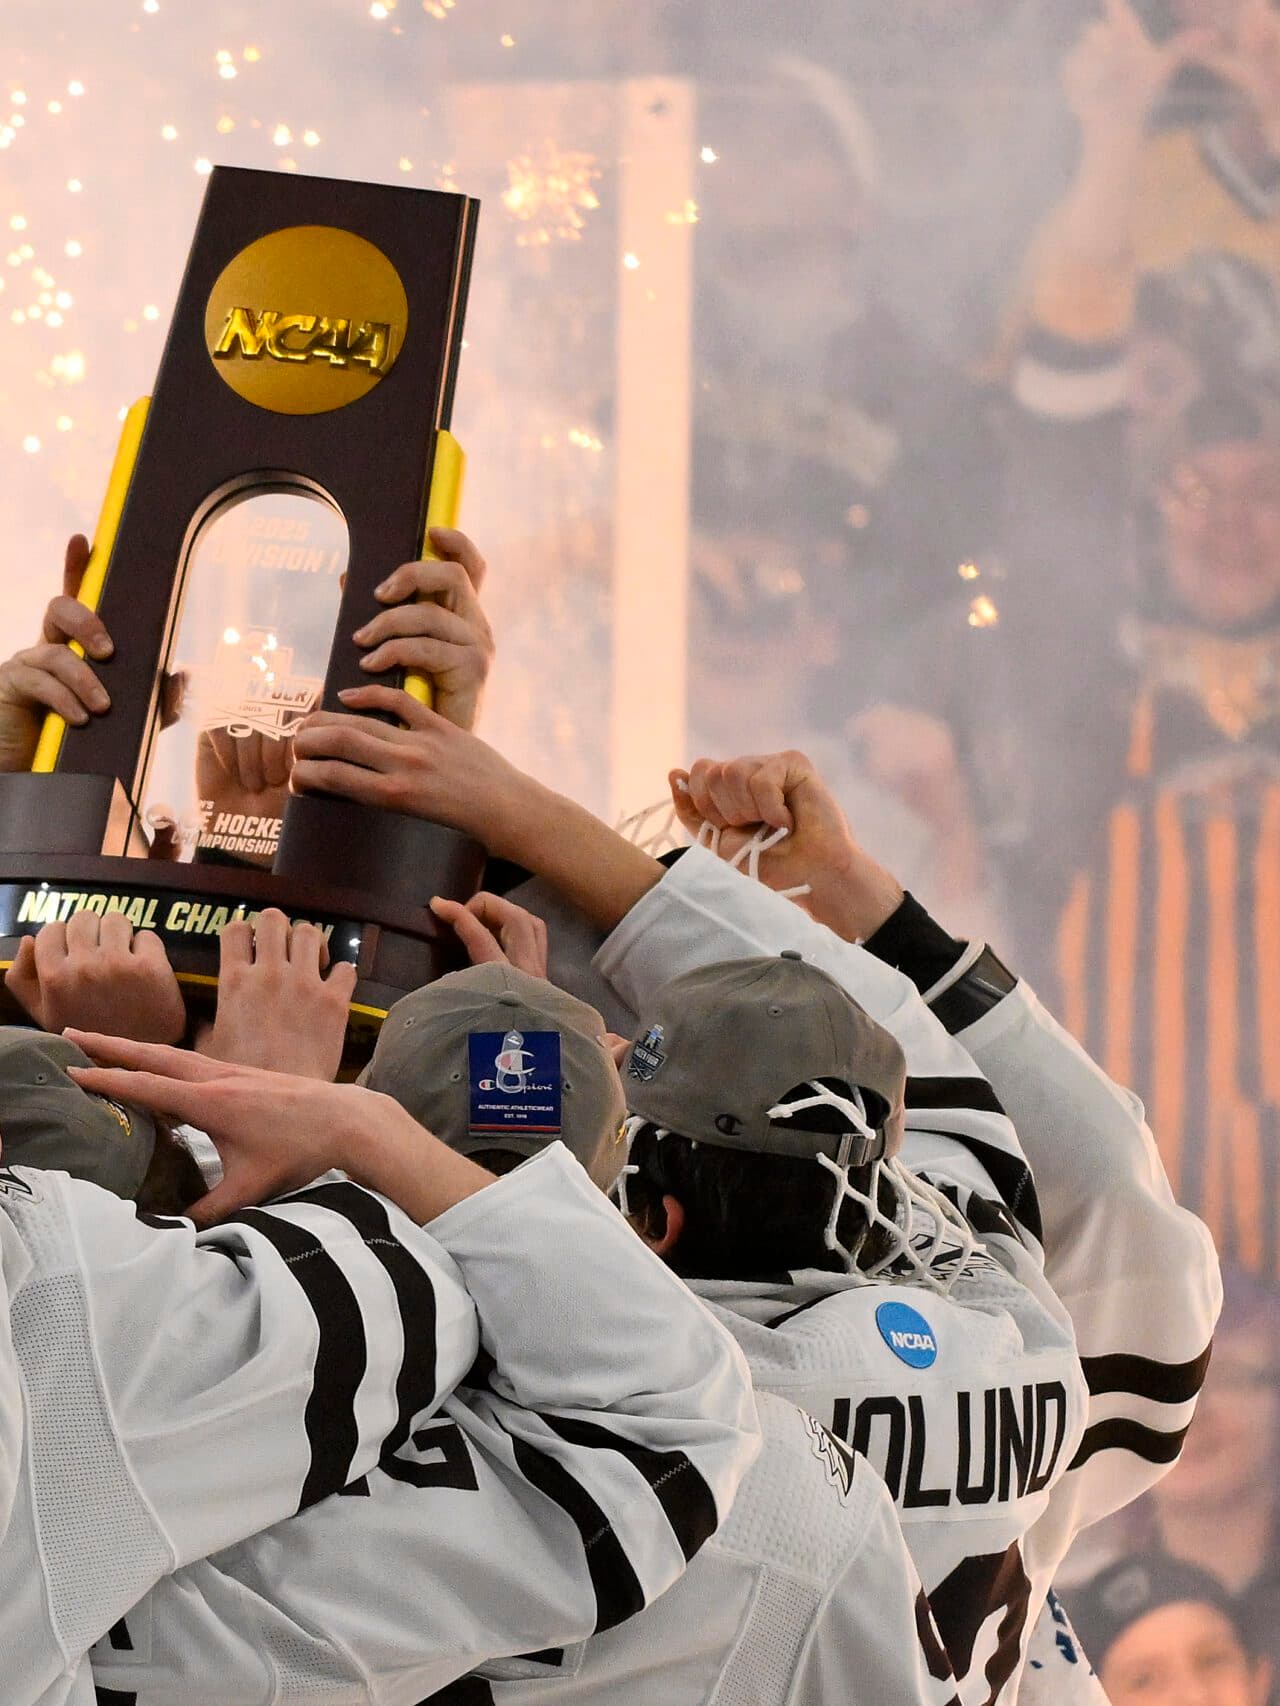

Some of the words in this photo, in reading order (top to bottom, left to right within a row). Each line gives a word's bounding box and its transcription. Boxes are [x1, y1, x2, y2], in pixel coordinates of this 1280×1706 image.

[214, 307, 391, 375] NCAA
[214, 812, 283, 839] HOCKE
[17, 891, 159, 929] NATIONAL
[890, 1330, 935, 1352] NCAA
